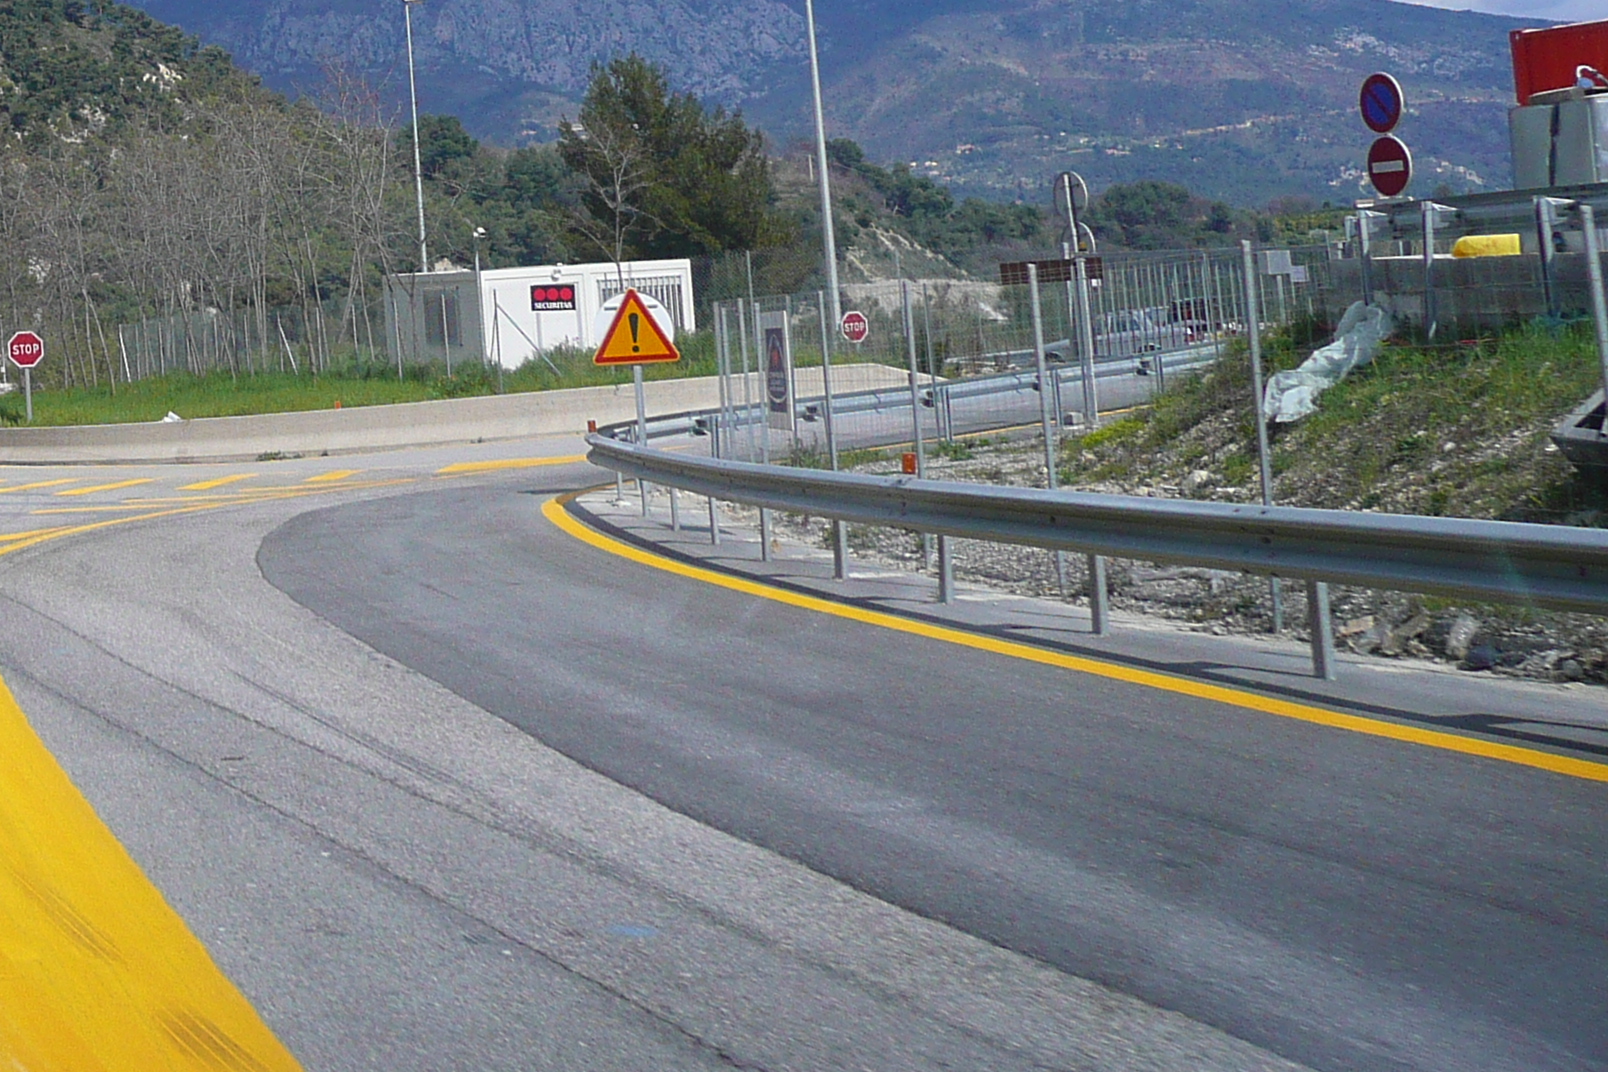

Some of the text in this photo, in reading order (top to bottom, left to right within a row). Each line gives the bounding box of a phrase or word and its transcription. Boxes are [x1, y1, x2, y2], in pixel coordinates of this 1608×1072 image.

[534, 301, 573, 309] SECURITAS
[844, 321, 865, 332] STOP
[12, 343, 39, 356] STOP
